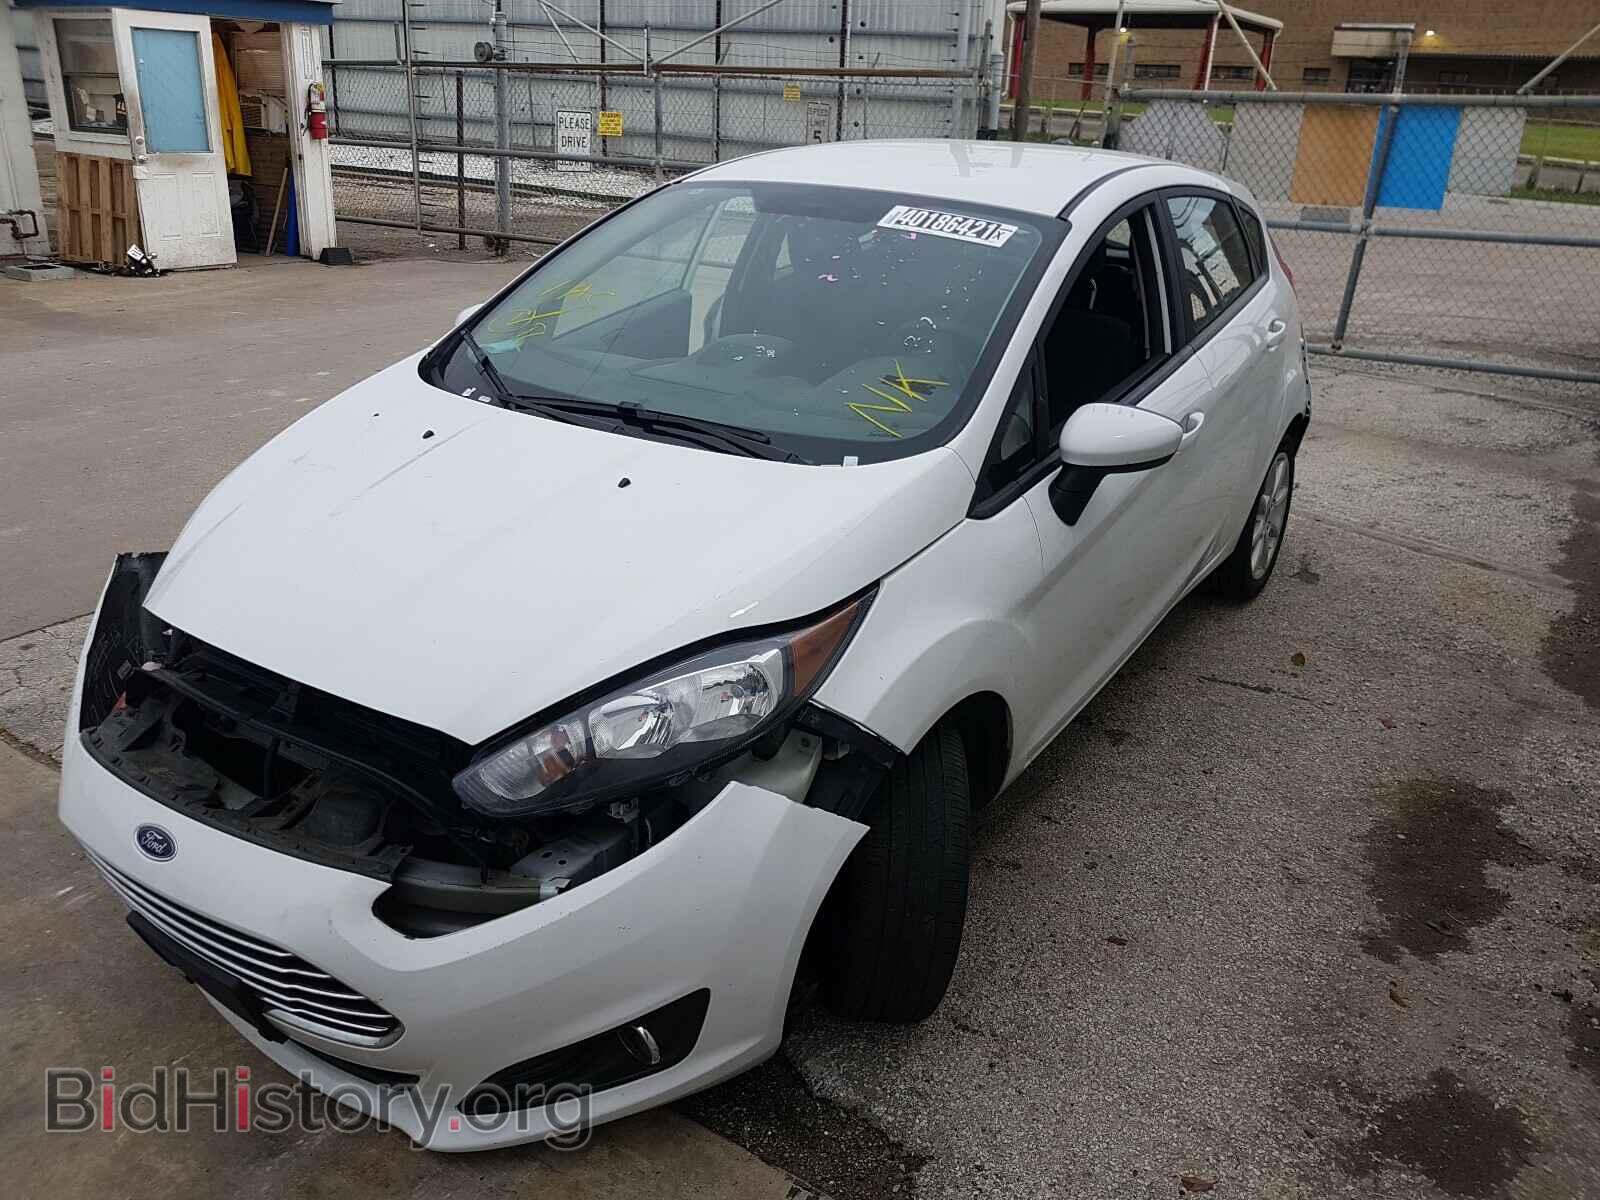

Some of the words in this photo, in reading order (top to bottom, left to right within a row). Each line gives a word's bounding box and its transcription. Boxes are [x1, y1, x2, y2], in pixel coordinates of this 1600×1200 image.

[559, 117, 590, 130] PLEASE
[561, 135, 588, 148] DRIVE
[898, 208, 997, 241] 40186421
[142, 830, 167, 854] Ford
